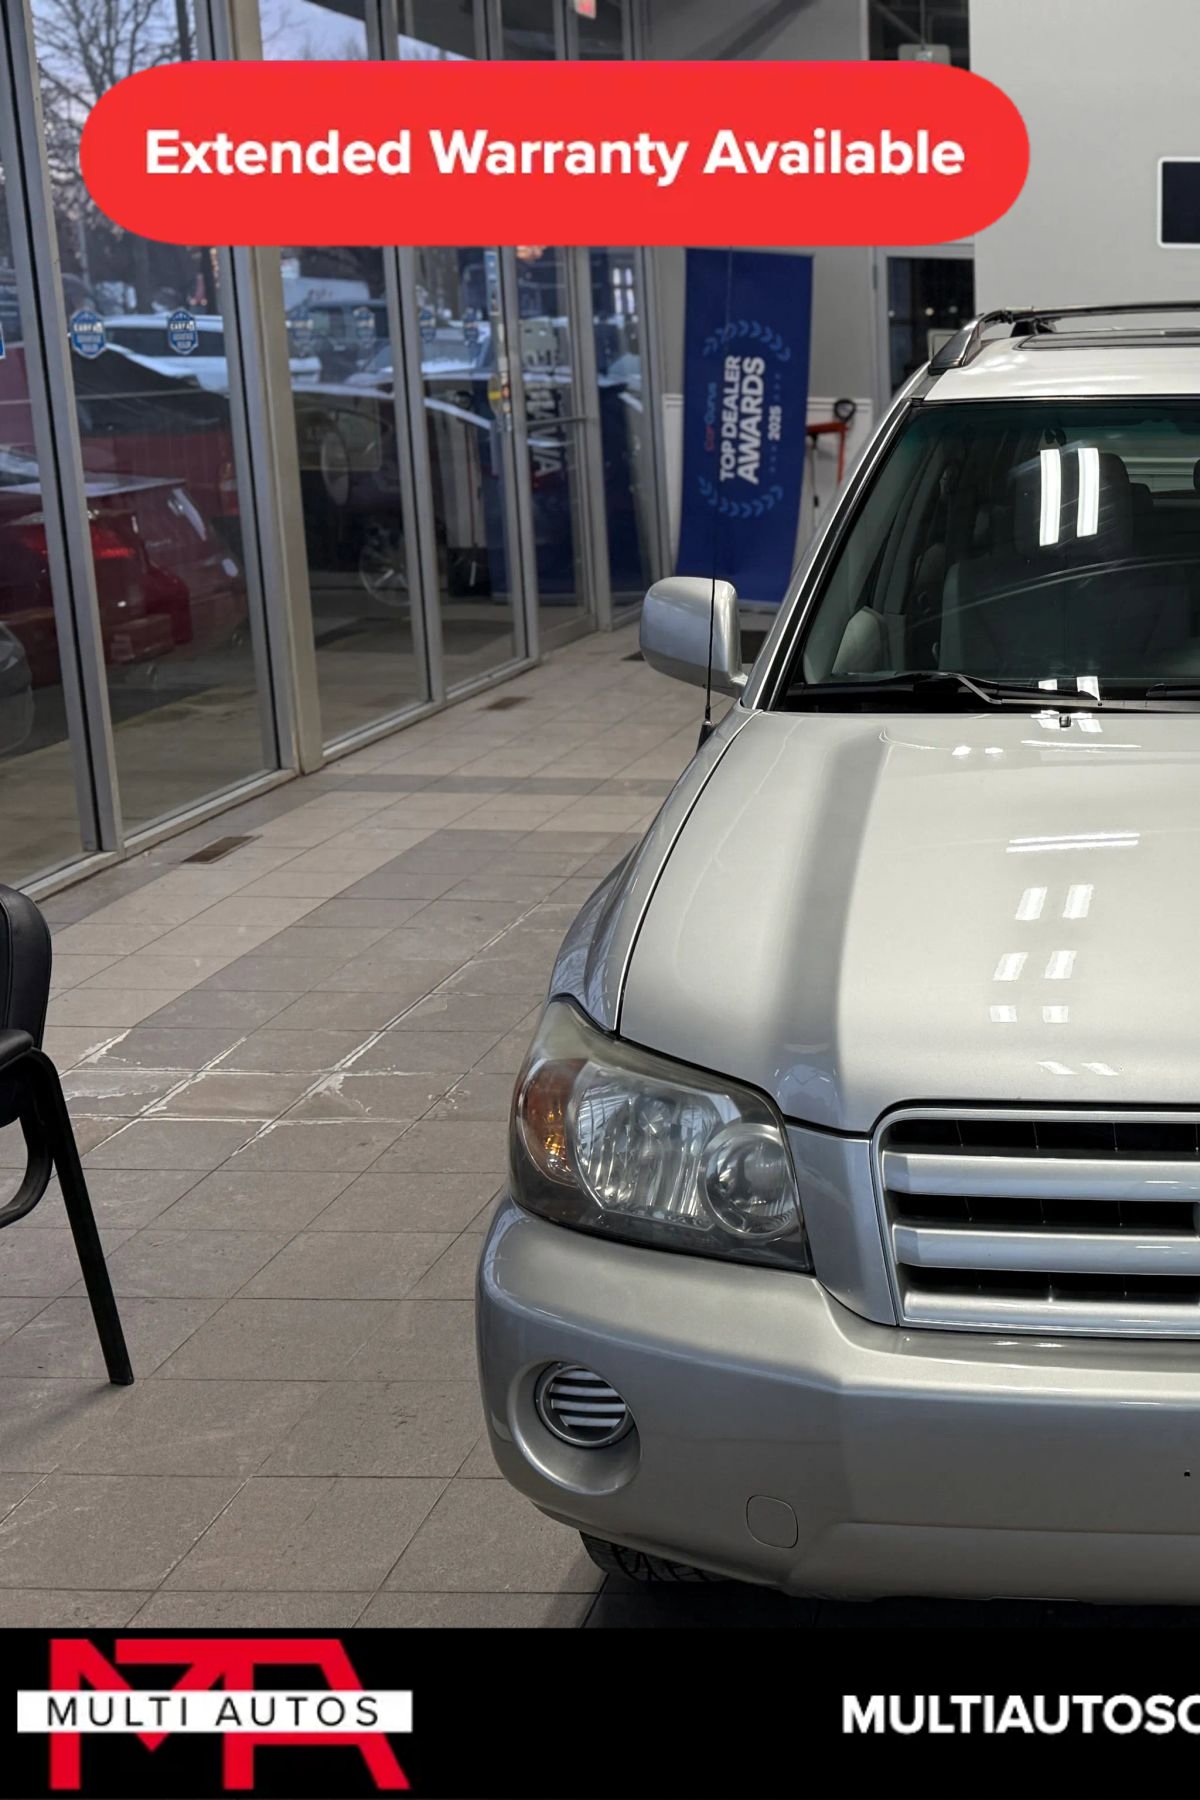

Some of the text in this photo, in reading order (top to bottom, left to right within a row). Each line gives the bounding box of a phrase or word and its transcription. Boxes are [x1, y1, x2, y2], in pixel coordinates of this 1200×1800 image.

[720, 355, 742, 483] TOP DEALER
[737, 356, 766, 486] AWARDS
